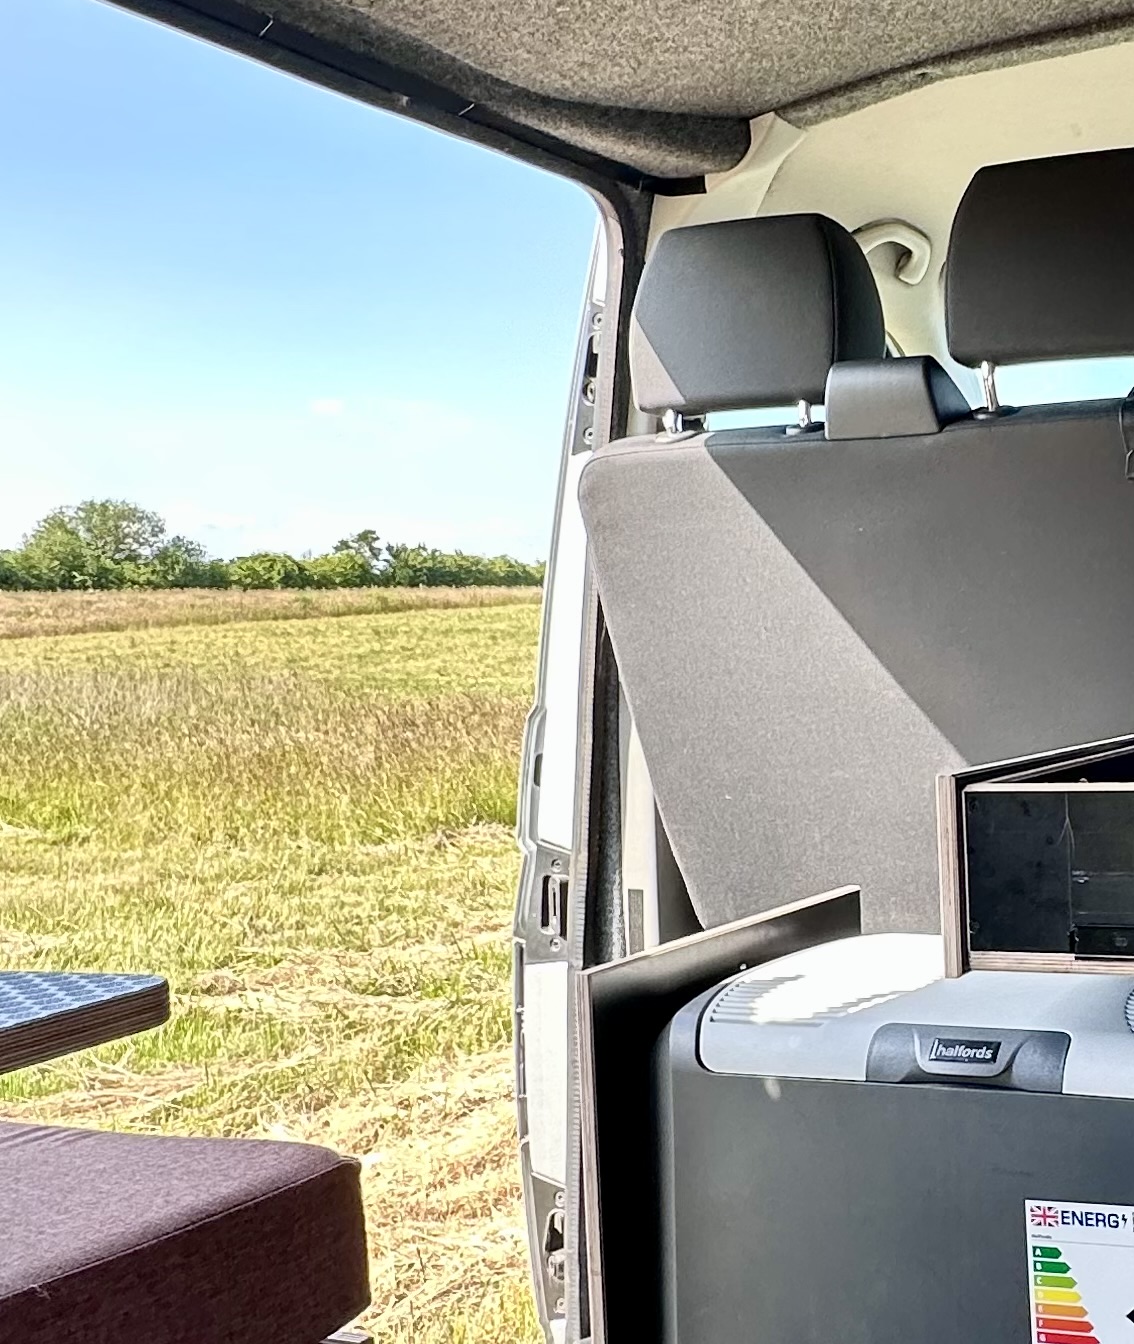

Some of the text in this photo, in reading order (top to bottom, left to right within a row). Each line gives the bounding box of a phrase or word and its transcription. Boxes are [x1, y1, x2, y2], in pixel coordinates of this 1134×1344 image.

[936, 1044, 994, 1060] halfords
[1060, 1210, 1120, 1229] ENERG
[1034, 1248, 1042, 1257] A
